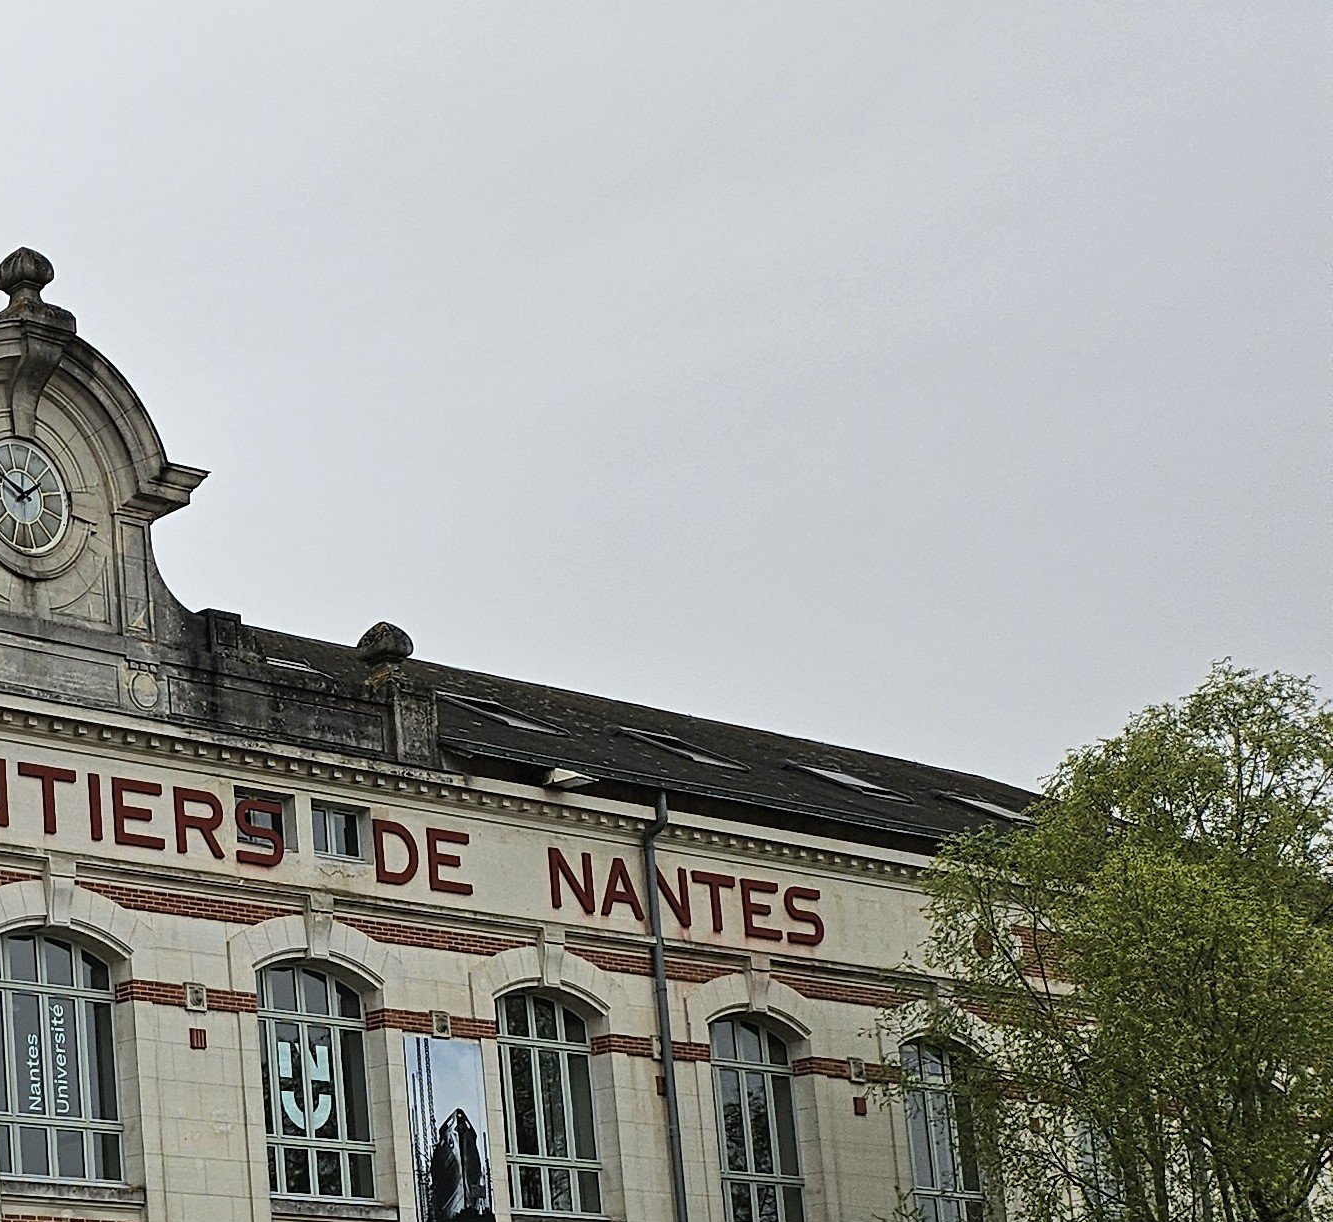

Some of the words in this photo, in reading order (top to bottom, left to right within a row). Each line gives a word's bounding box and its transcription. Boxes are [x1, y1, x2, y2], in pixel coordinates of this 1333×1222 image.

[371, 818, 474, 896] DE
[546, 846, 826, 946] NANTES
[26, 1033, 43, 1111] Nantes
[49, 1004, 70, 1114] Université
